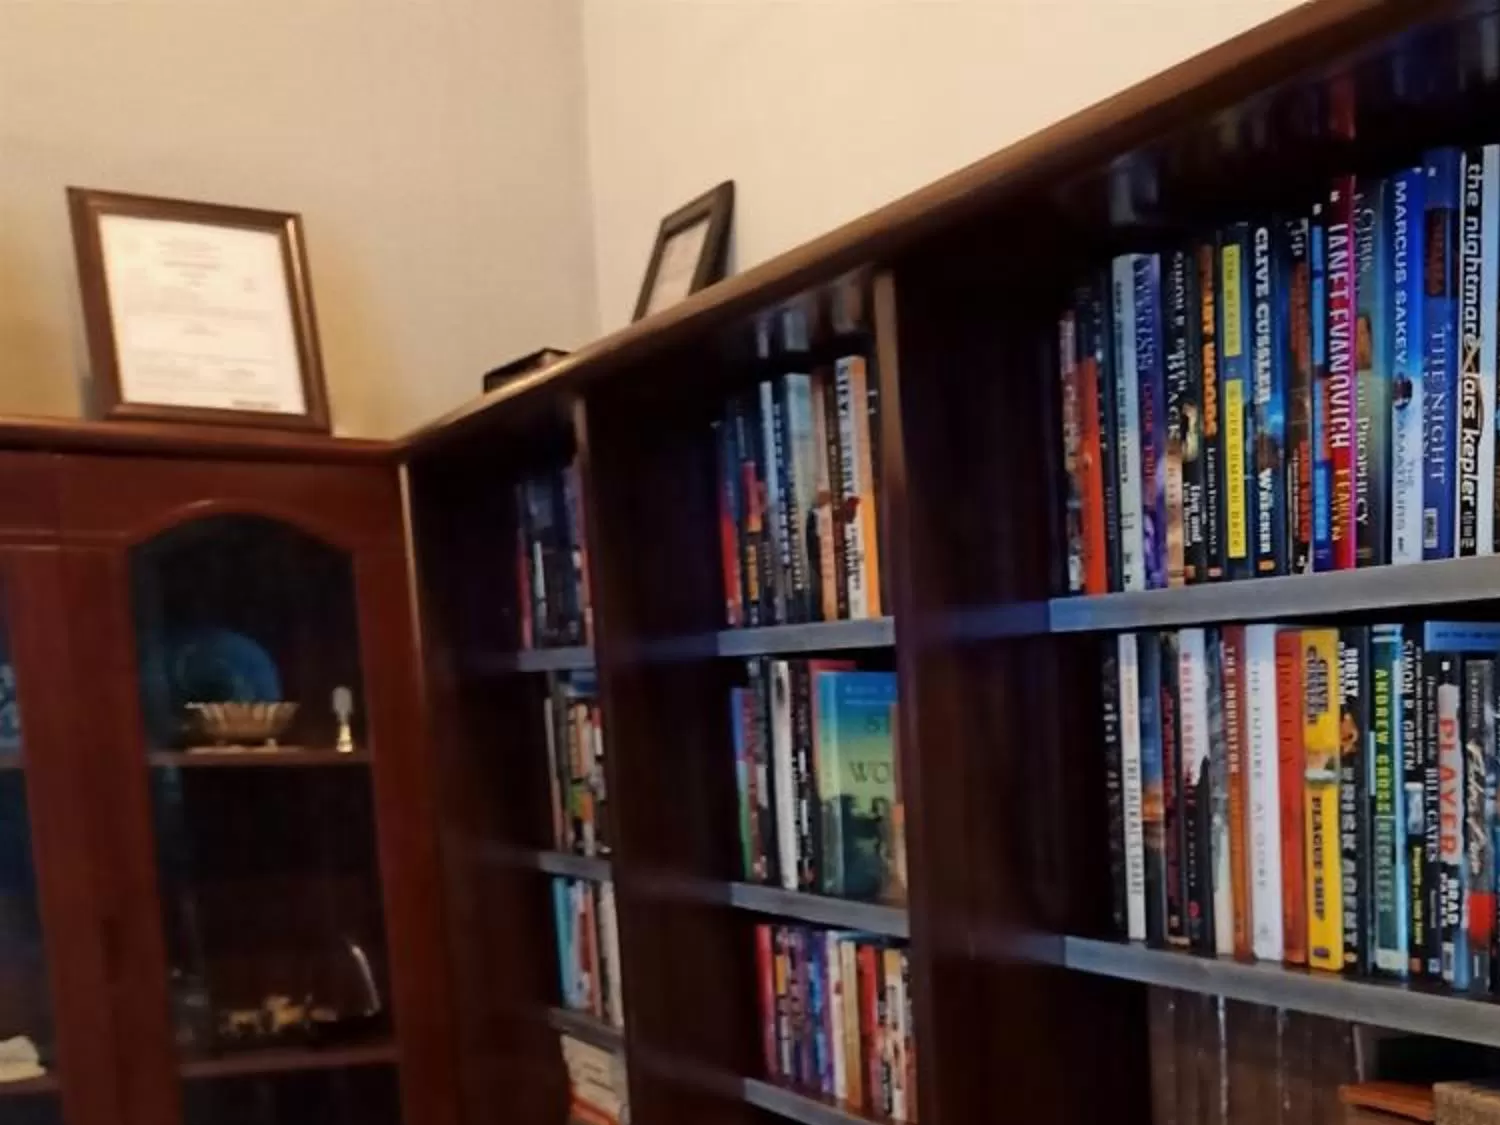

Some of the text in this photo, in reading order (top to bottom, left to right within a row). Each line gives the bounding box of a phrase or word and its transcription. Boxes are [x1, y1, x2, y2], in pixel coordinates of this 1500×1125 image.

[1254, 227, 1270, 298] CLIVE
[1394, 180, 1408, 365] MARCUS SAKEY
[1463, 163, 1484, 348] the nightmare
[1328, 308, 1351, 449] EVANOVICH
[1430, 327, 1447, 485] THE NIGHT
[1462, 372, 1480, 419] lars
[1460, 428, 1480, 506] kepler
[1225, 646, 1238, 676] THE
[1402, 640, 1415, 694] SIMON
[1225, 683, 1240, 774] INQUISITOR
[1375, 669, 1389, 745] ANDREW
[1403, 720, 1415, 771] GREEN
[1342, 783, 1357, 850] RISK
[1438, 718, 1458, 856] PLAYER
[1312, 797, 1325, 869] PLAGUE
[1425, 809, 1440, 863] GATES
[1446, 879, 1460, 926] BRAD
